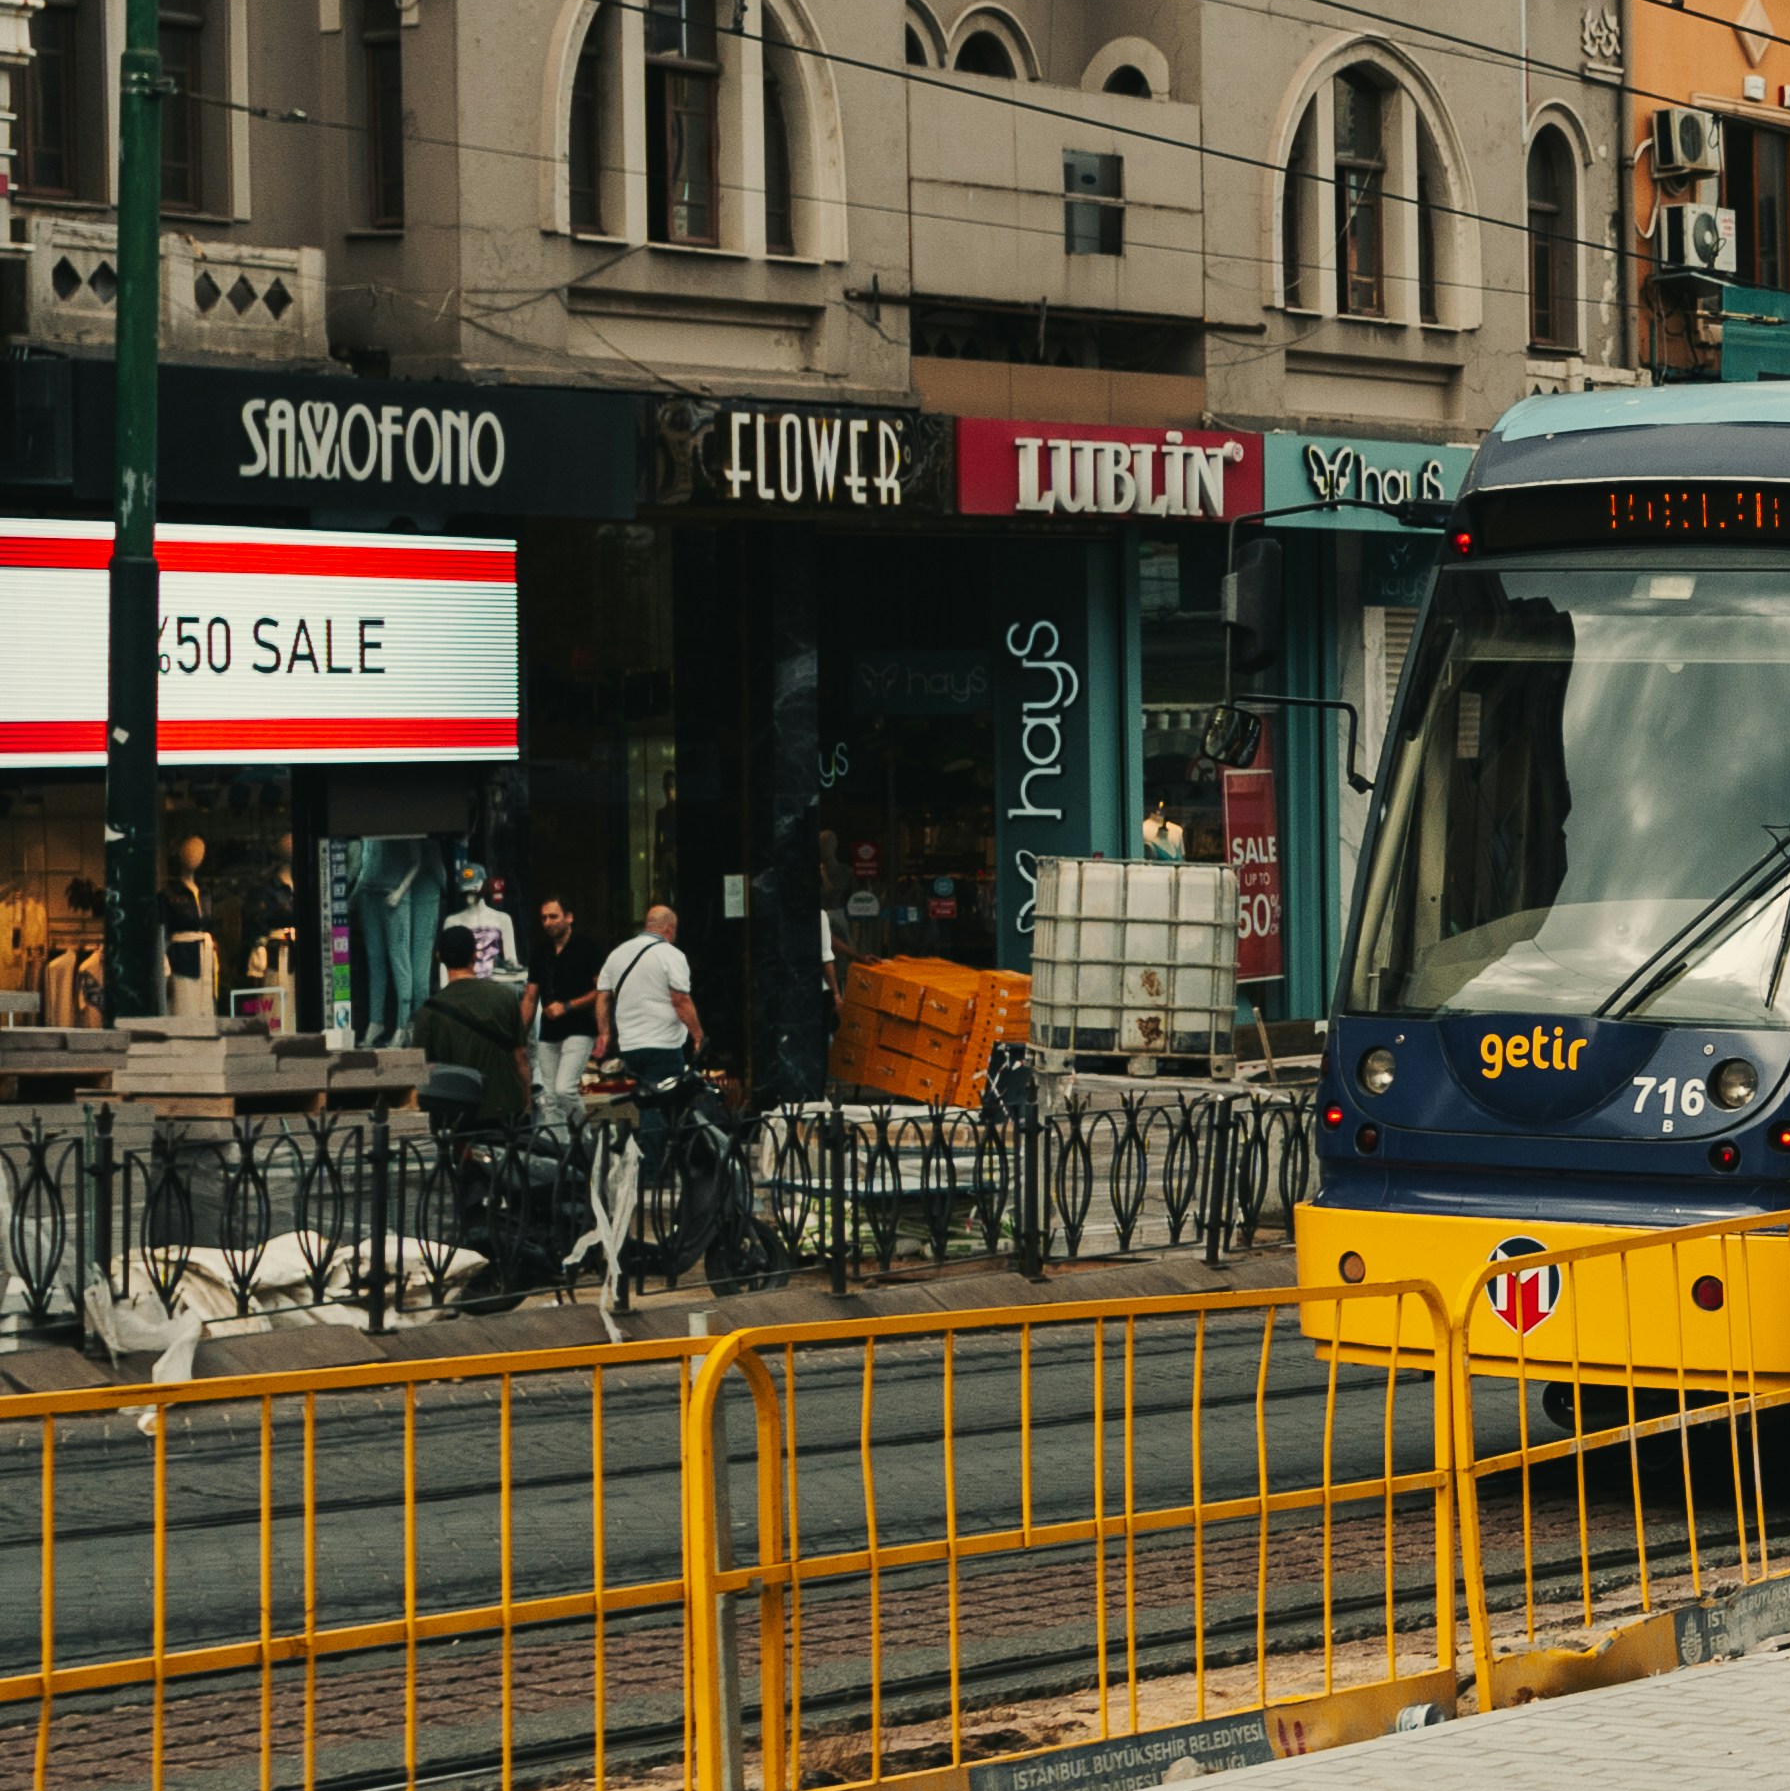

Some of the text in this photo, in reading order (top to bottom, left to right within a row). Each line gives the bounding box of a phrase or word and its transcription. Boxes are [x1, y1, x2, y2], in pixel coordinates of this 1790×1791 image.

[723, 411, 902, 505] FLOWER
[252, 616, 386, 674] SALE
[1006, 620, 1080, 820] hays
[1232, 836, 1277, 865] SALE
[1244, 871, 1271, 887] UP TO
[1480, 1025, 1588, 1079] getir
[1633, 1076, 1706, 1117] 716
[1662, 1119, 1674, 1133] B
[1013, 1717, 1265, 1791] İSTANBUL BÜYÜKŞEHİR BELEDİYESİ
